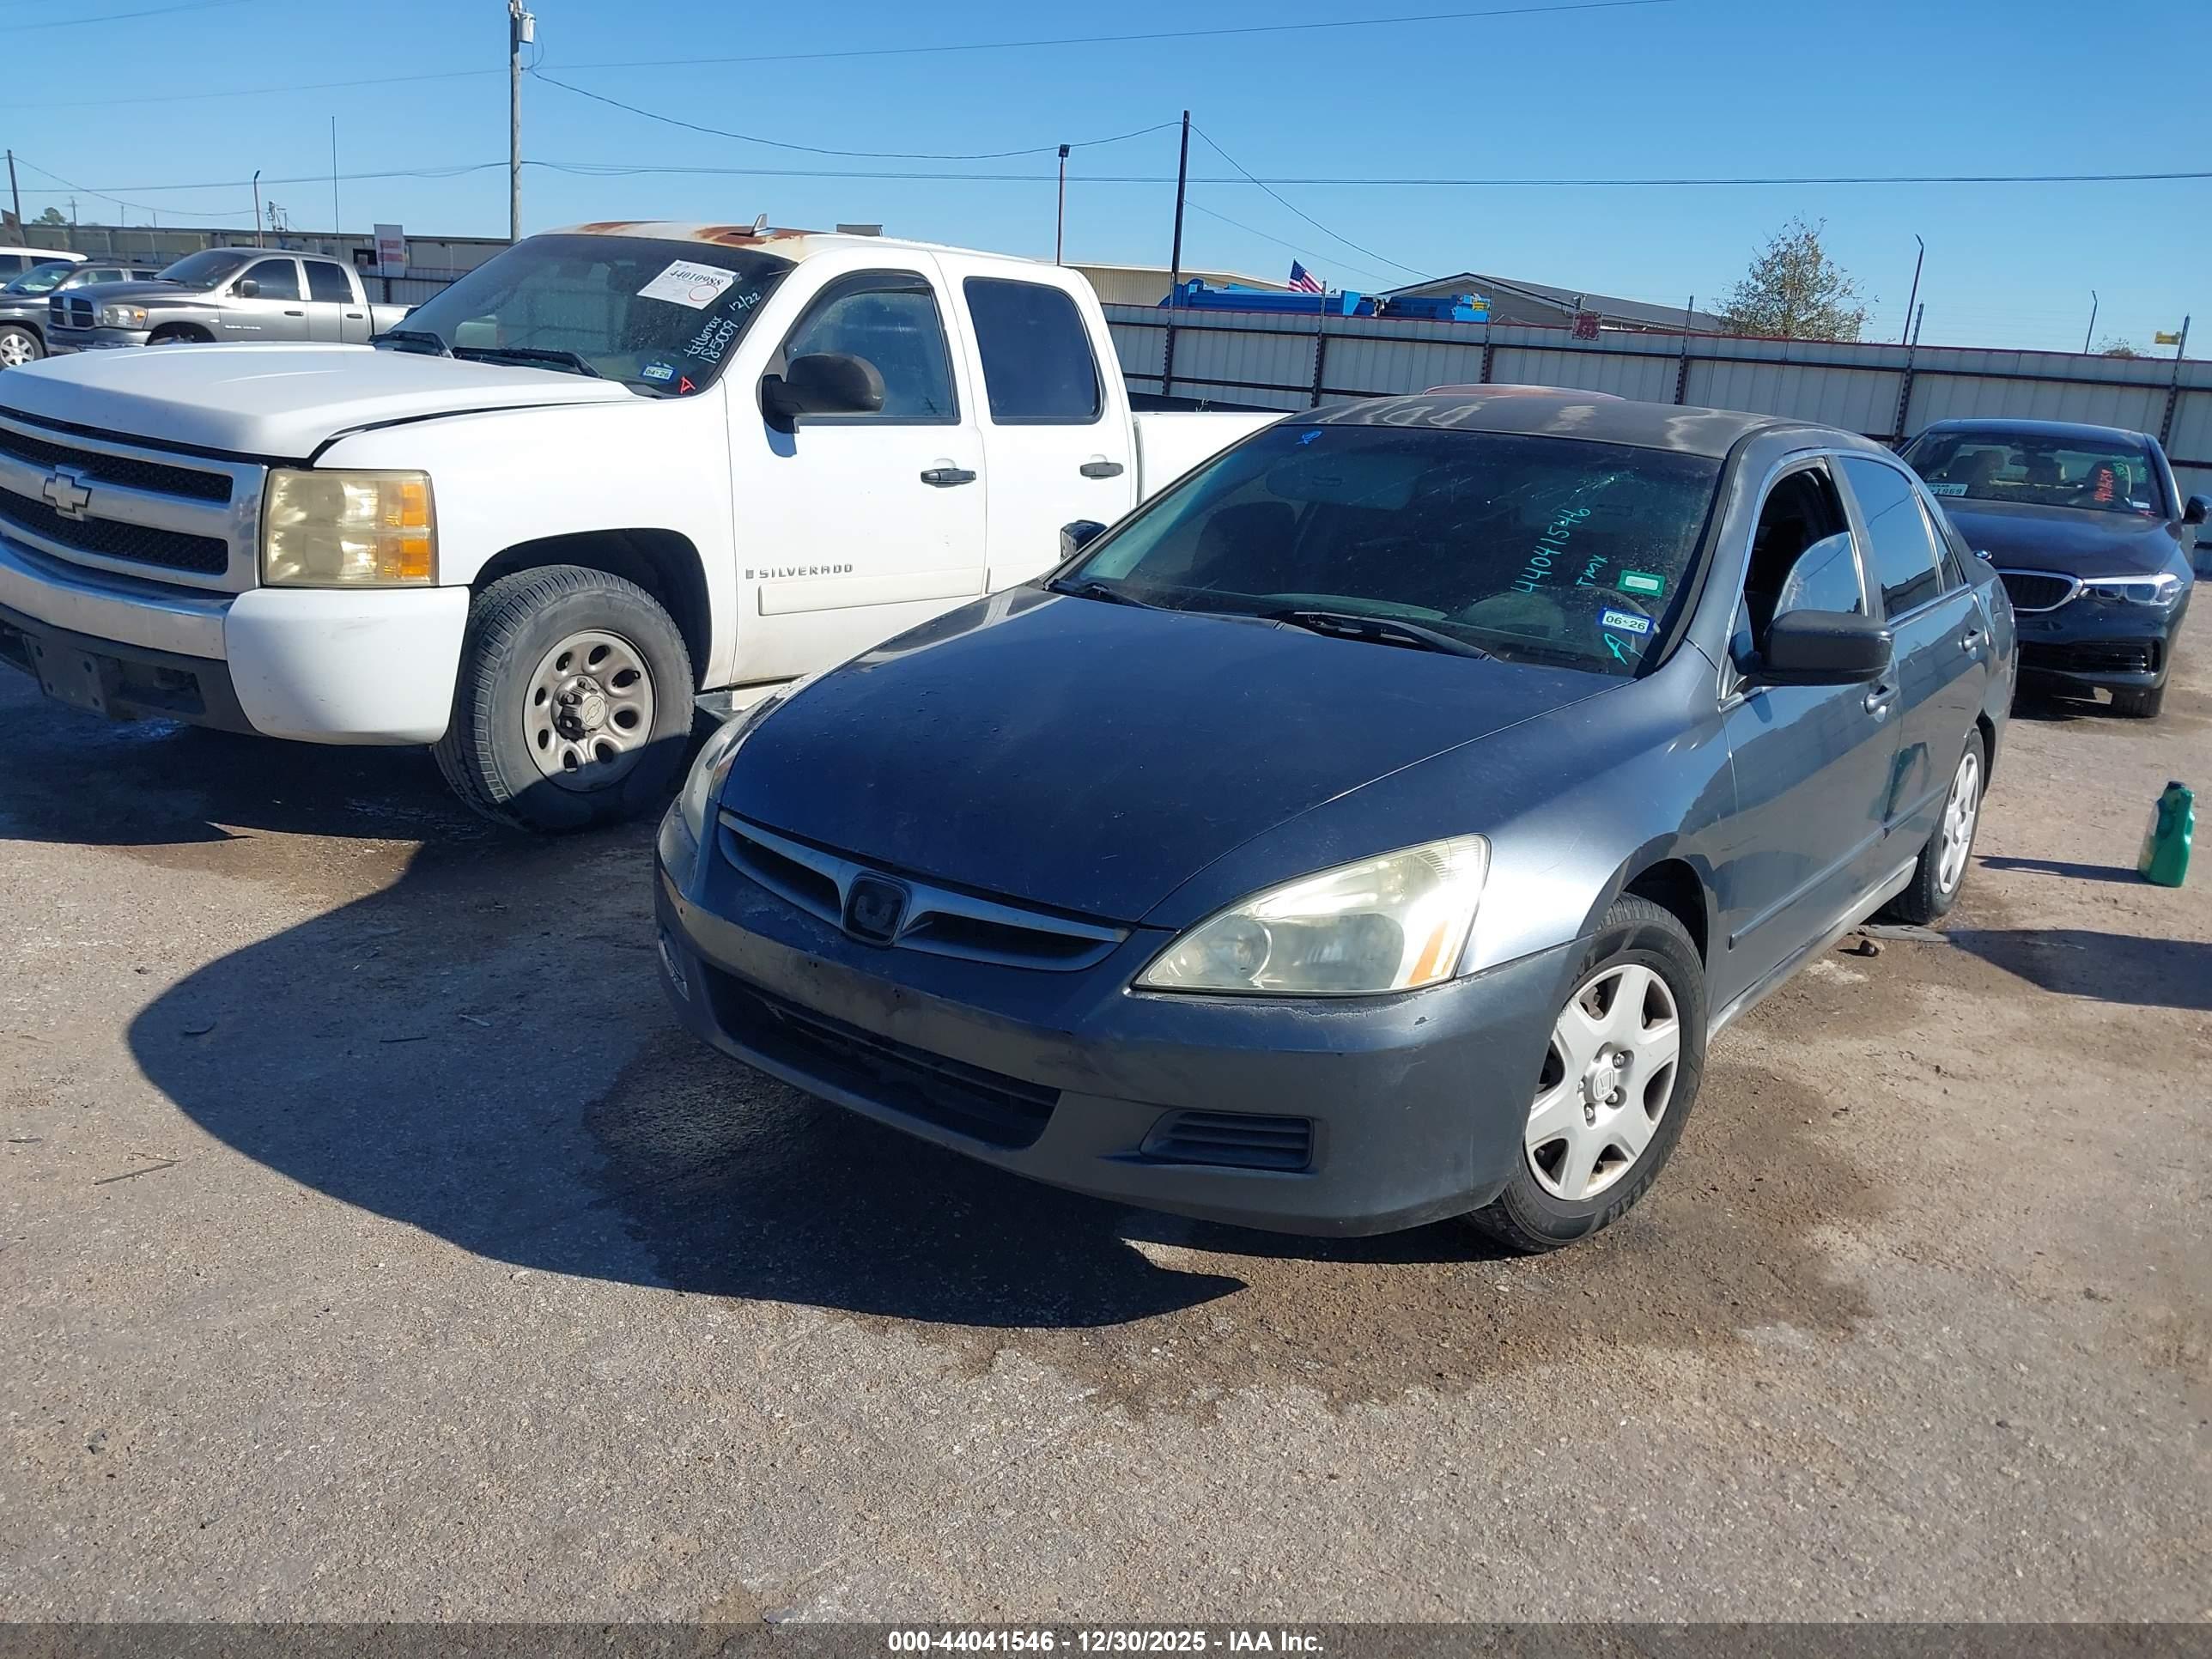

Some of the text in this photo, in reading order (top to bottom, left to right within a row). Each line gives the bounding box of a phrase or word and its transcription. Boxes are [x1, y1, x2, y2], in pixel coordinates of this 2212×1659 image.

[728, 292, 761, 311] 12/22
[698, 319, 738, 364] 185009
[1510, 508, 1591, 592] 44041546
[759, 563, 854, 579] SILVERADO
[1577, 555, 1608, 586] TMX
